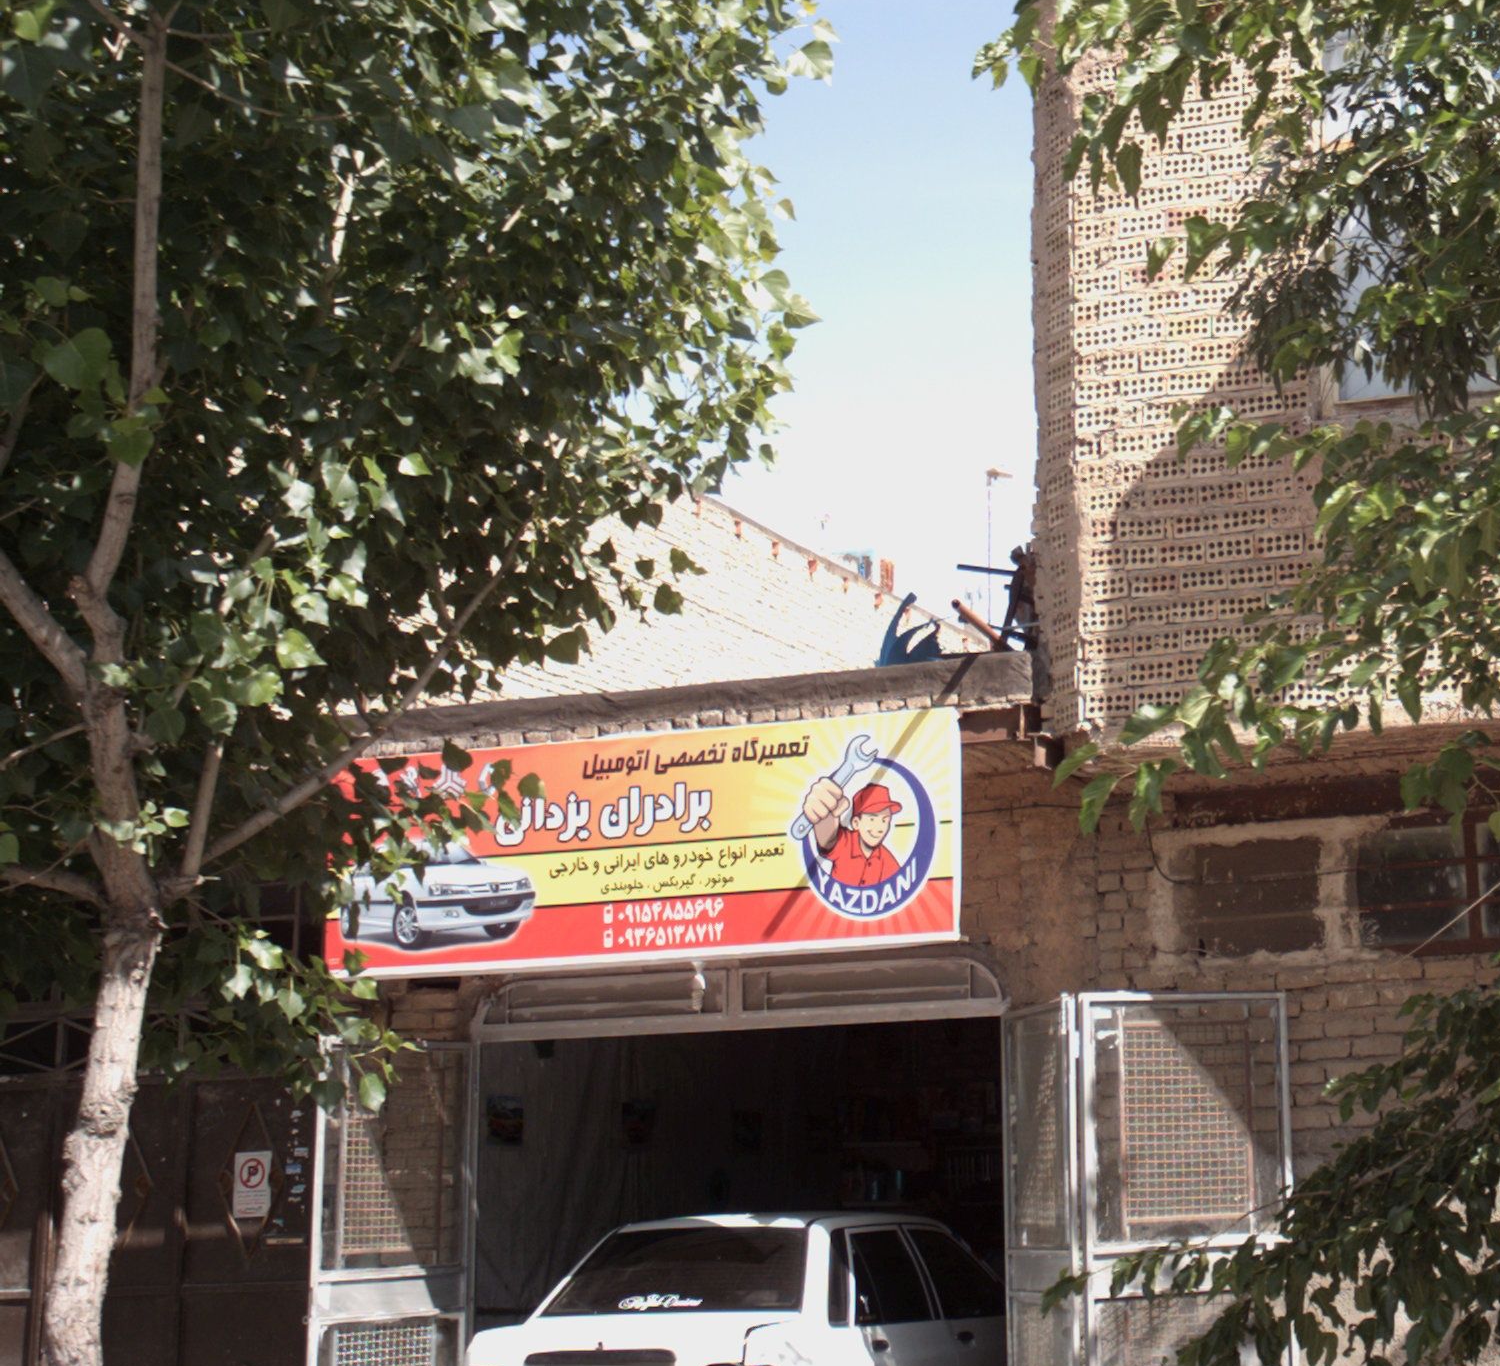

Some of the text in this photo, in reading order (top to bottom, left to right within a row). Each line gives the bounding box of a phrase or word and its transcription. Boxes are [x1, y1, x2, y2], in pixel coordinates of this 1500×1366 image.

[582, 735, 810, 780] تعمیرگاه تخصصی اتومبیل
[495, 781, 712, 847] برادران یزدانی
[604, 852, 640, 875] ایرانی
[644, 850, 669, 870] های
[718, 844, 747, 868] انواع
[750, 843, 785, 863] تعمیر
[549, 856, 589, 879] خارجی
[592, 860, 600, 875] و
[600, 873, 735, 895] موتور گیربکس جلوبندی
[816, 856, 917, 915] YAZDANI
